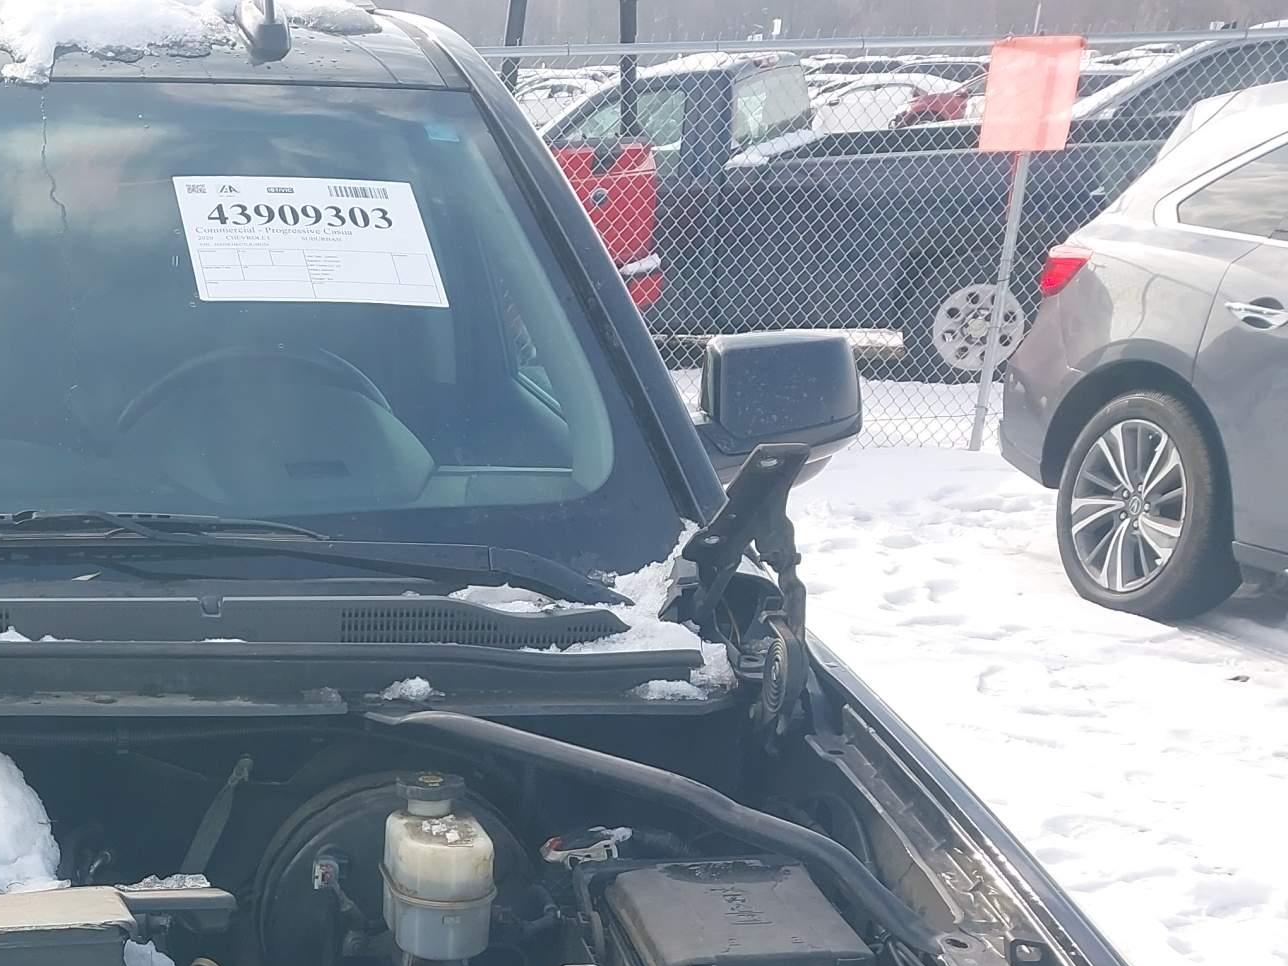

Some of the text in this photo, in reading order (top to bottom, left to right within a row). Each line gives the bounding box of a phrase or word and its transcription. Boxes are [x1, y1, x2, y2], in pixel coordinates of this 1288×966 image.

[207, 203, 393, 229] 43909303
[195, 226, 255, 235] Commercial
[265, 227, 320, 236] Progressive
